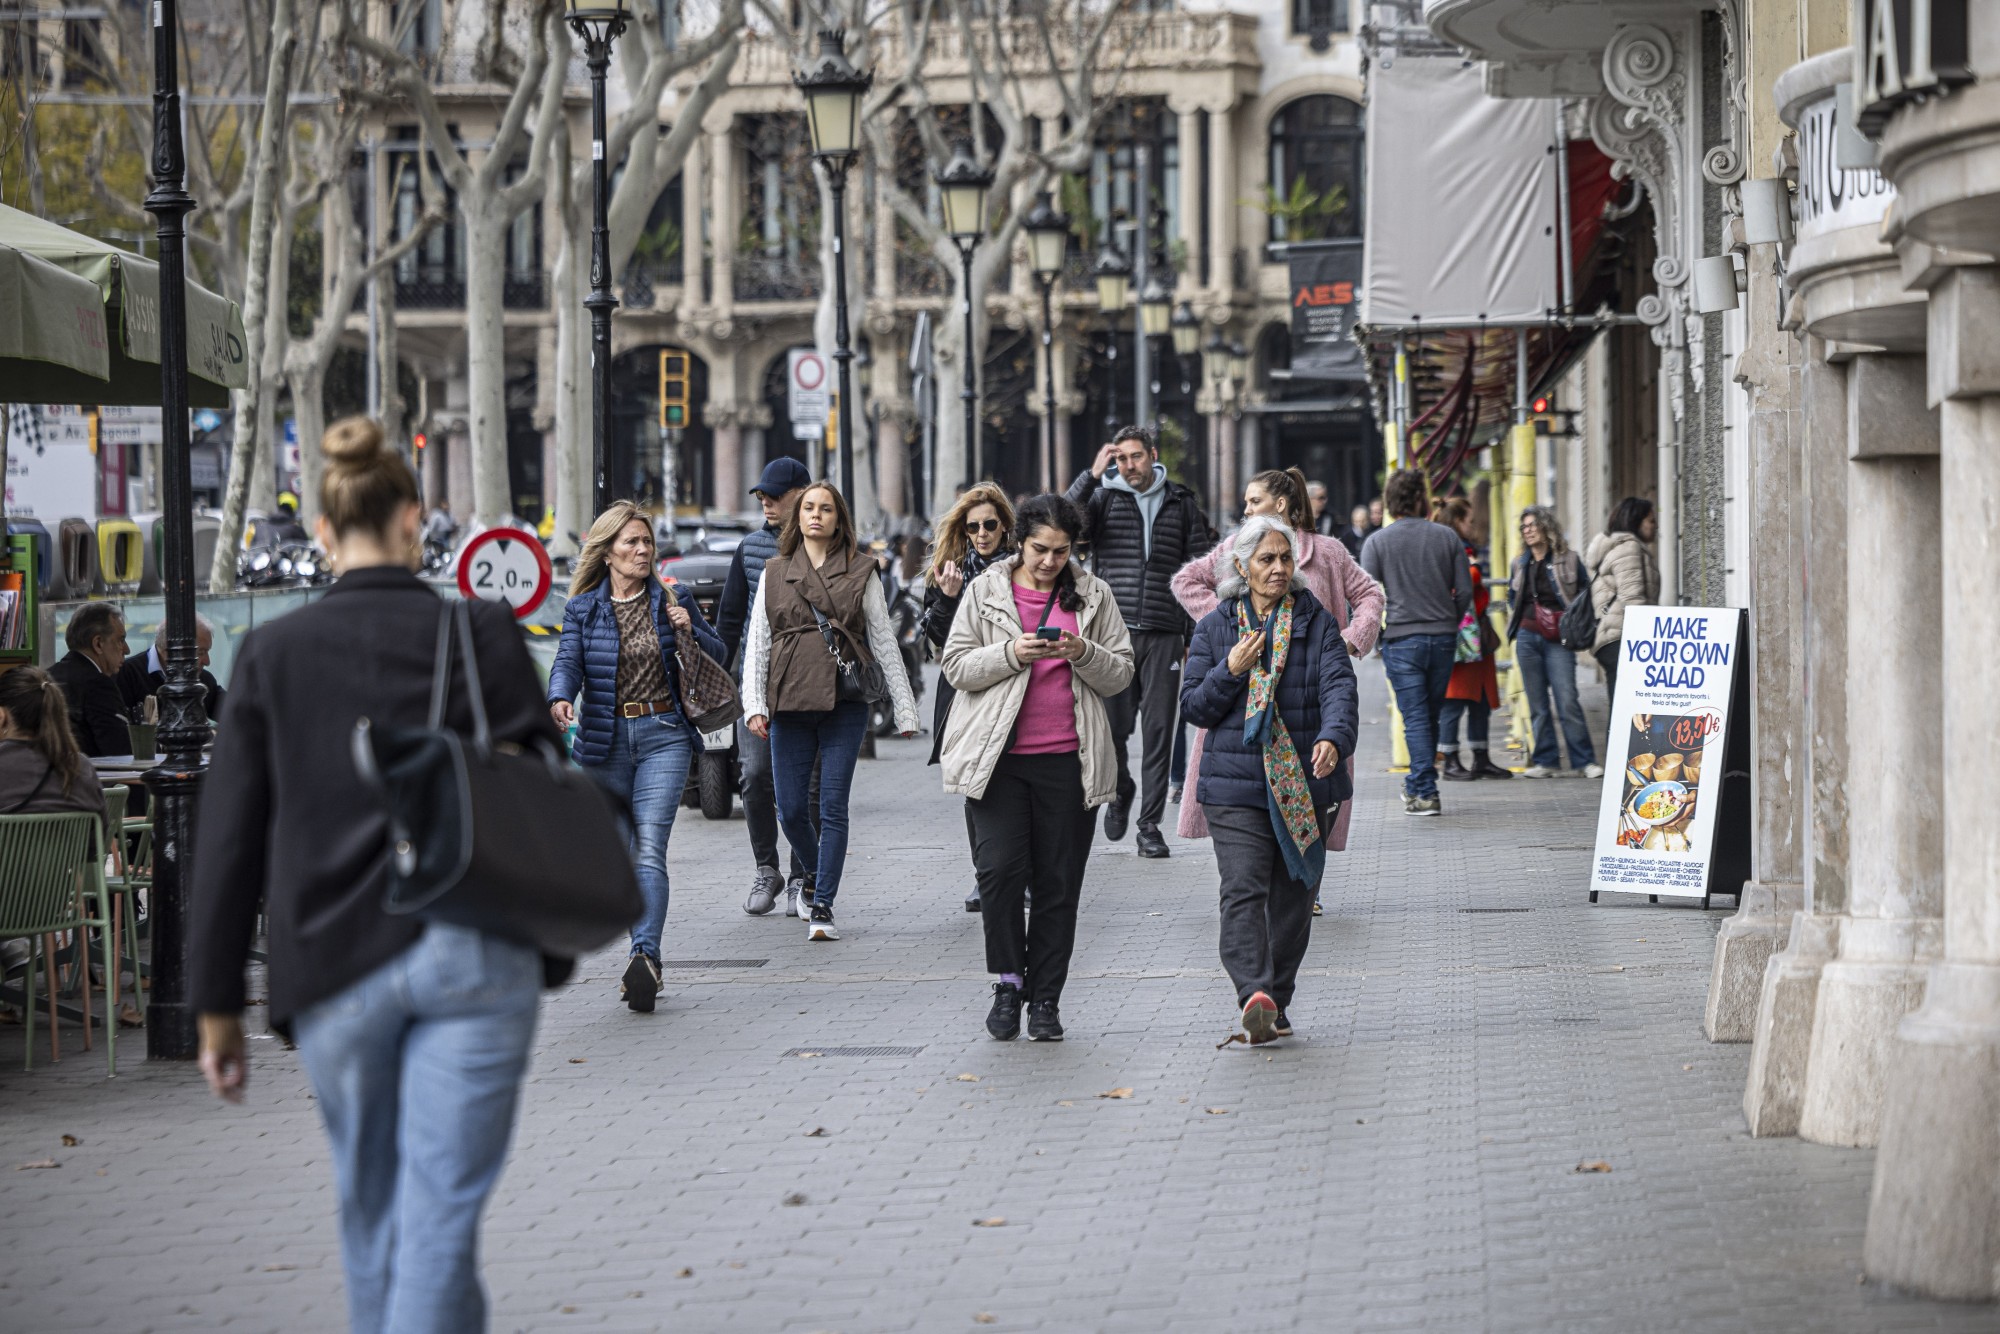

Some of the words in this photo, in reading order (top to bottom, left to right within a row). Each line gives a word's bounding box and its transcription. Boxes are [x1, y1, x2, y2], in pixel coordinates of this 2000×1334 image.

[1653, 617, 1708, 640] MAKE
[1627, 640, 1678, 663] YOUR
[1680, 642, 1730, 666] OWN
[1644, 665, 1705, 689] SALAD
